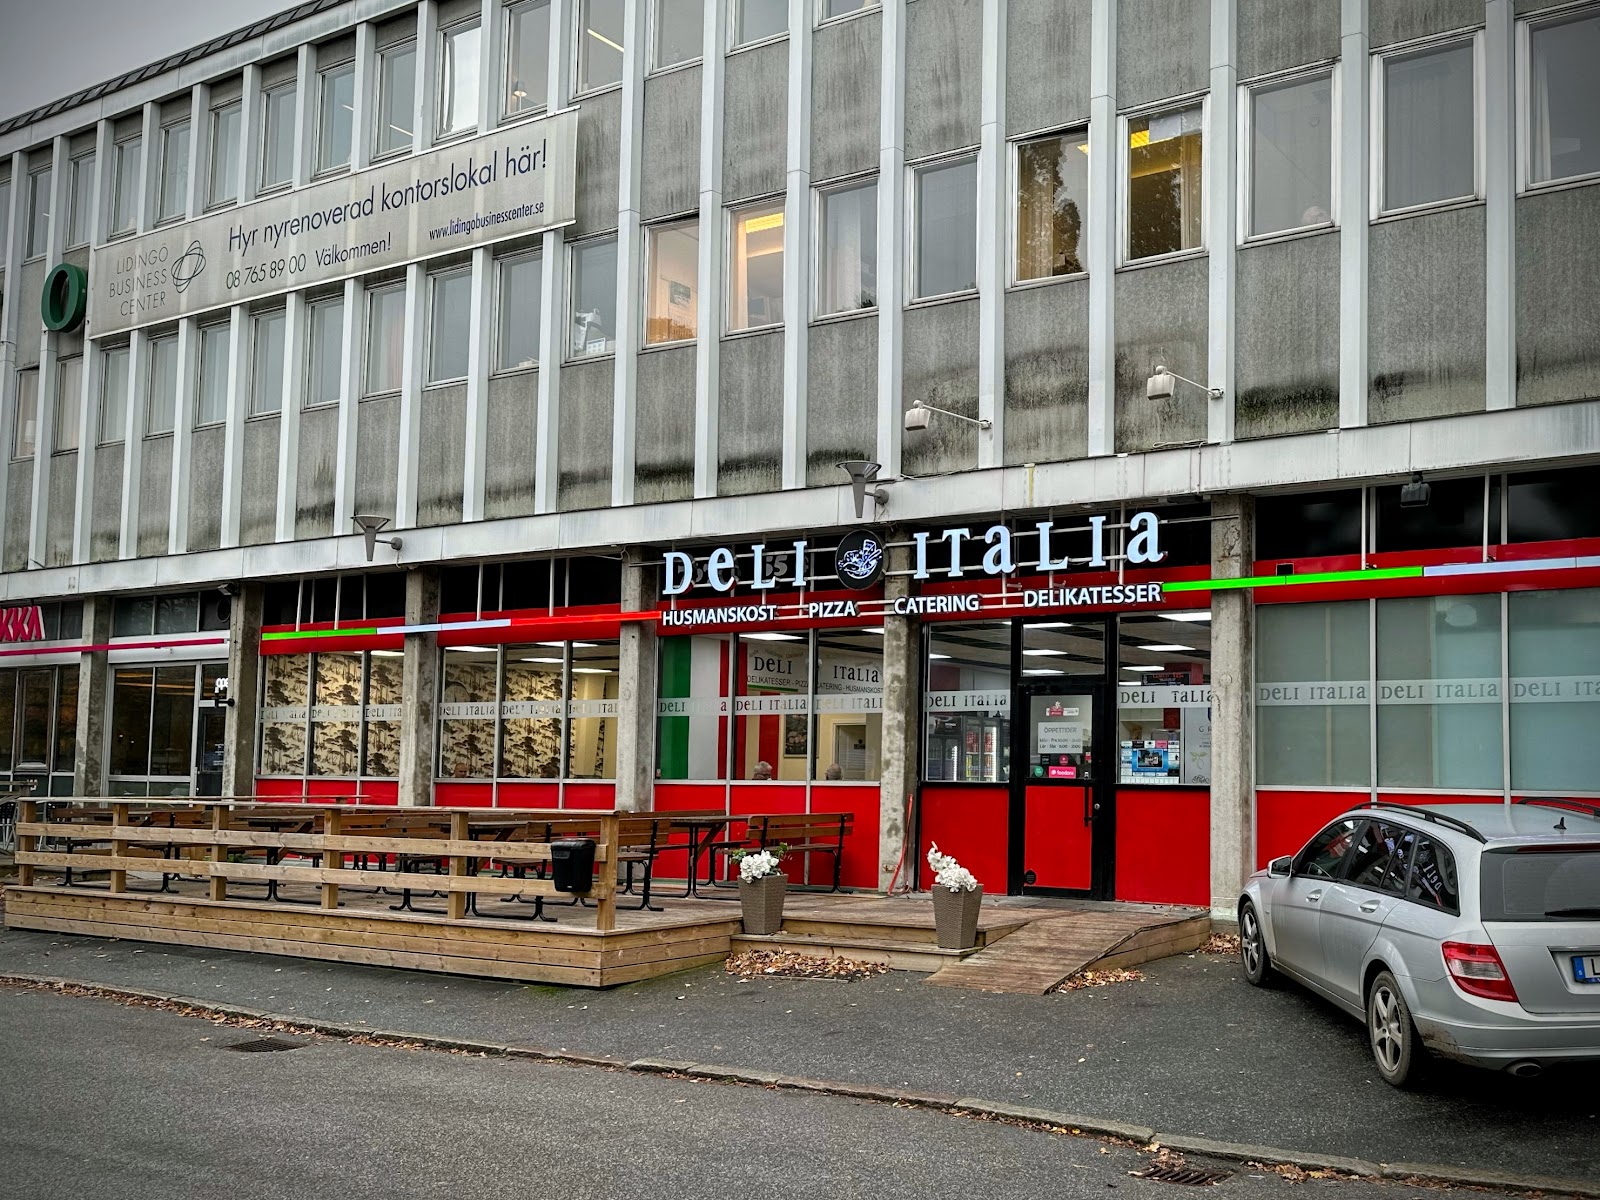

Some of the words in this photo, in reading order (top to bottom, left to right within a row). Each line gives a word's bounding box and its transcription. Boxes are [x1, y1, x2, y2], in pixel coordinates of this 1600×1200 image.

[229, 225, 258, 257] Hyr
[264, 185, 374, 254] nyrenoverad
[381, 150, 497, 211] kontorslokal
[505, 139, 547, 178] här!
[429, 201, 545, 241] www.lidingobusinesscenter.se
[116, 243, 169, 275] LIDINGÖ
[226, 269, 241, 290] 08
[243, 264, 266, 286] 765
[270, 259, 285, 280] 89
[288, 253, 307, 275] 00
[315, 232, 391, 267] Välkommen!
[109, 269, 167, 298] BUSINESS
[120, 291, 166, 317] CENTER
[662, 604, 777, 626] HUSMANSKOST
[808, 600, 856, 618] PIZZA
[894, 594, 980, 615] CATERING
[1024, 583, 1161, 608] DELIKATESSER
[747, 675, 791, 687] DELIKATESSER
